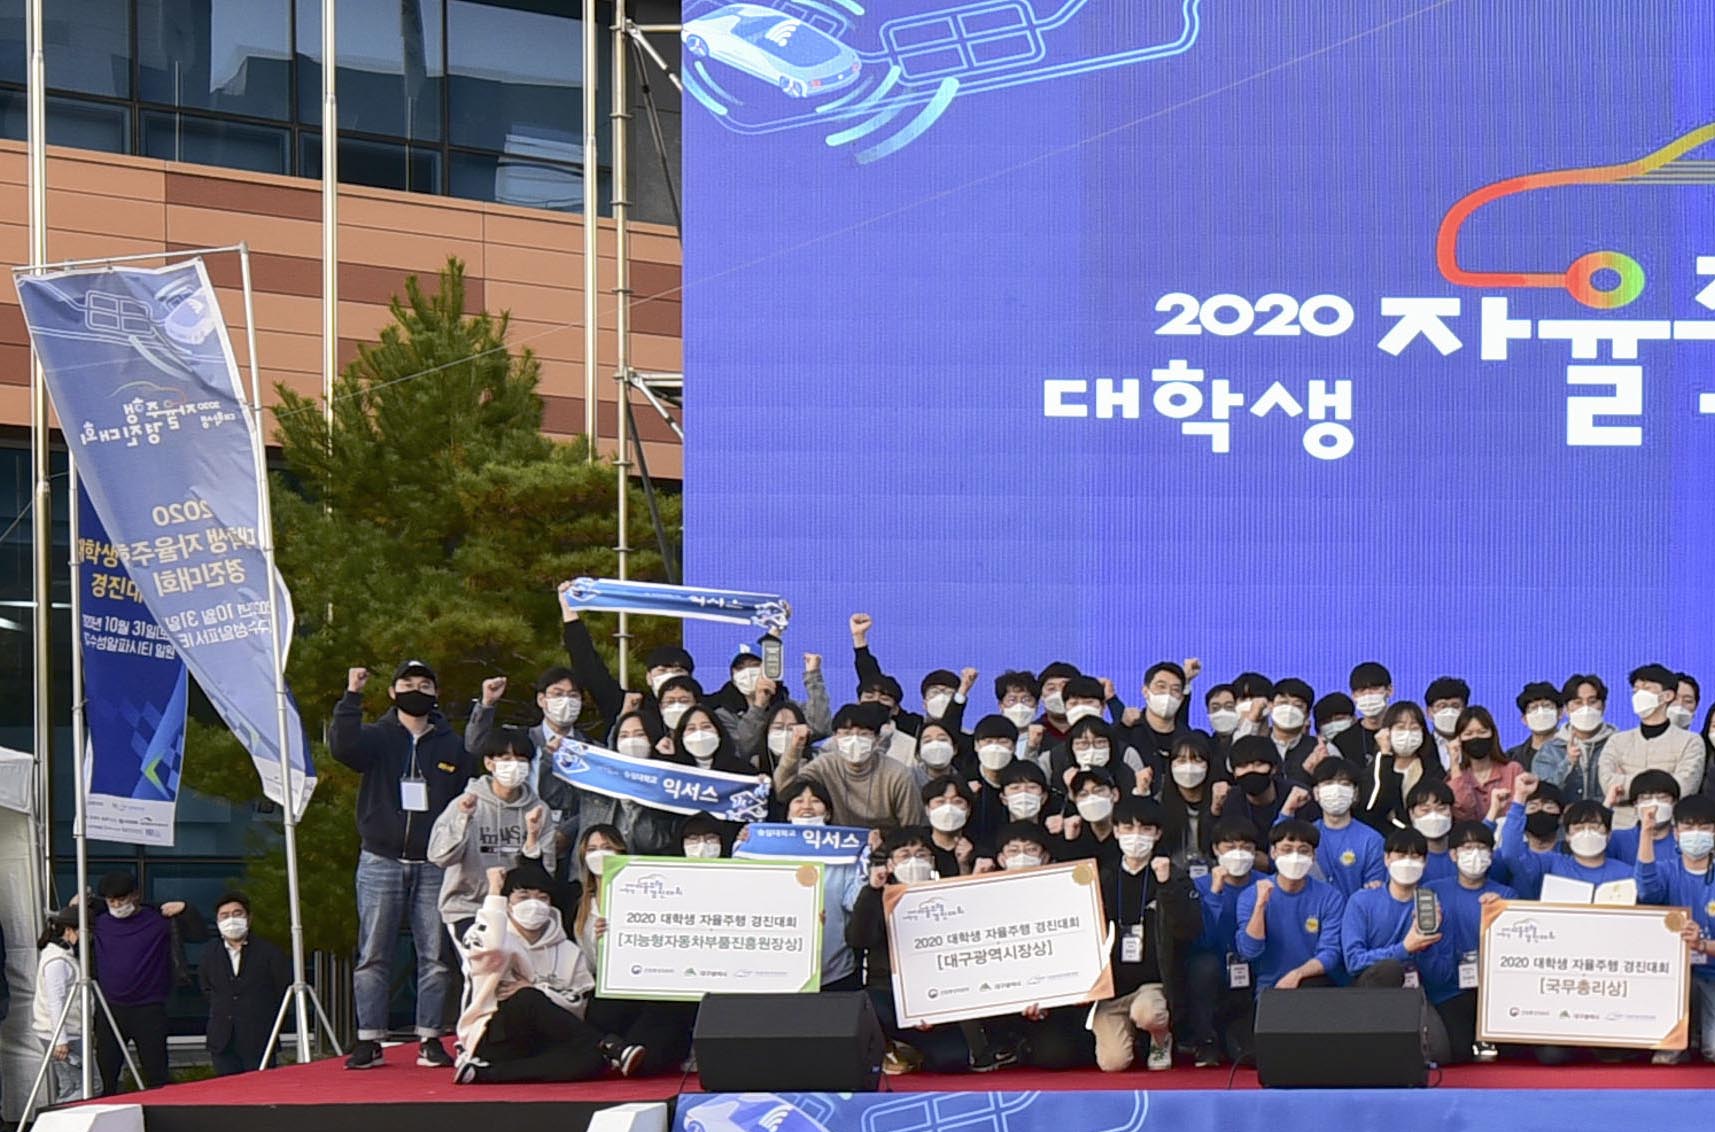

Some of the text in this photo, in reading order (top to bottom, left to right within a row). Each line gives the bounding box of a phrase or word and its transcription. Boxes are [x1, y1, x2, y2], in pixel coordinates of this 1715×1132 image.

[1155, 290, 1355, 338] 2020
[1043, 358, 1354, 460] 대학생
[663, 778, 719, 803] 익서스
[802, 829, 860, 850] 익서스
[626, 911, 797, 928] 2020 대학생 자율주행 경진대회
[914, 916, 1080, 949] 2020 대학생 자율주행 경진대회
[937, 940, 1053, 971] [대구광역시장상]
[1500, 956, 1670, 974] 2020 대학생 자율주행 경진대회
[1539, 977, 1628, 997] [국무총리상]
